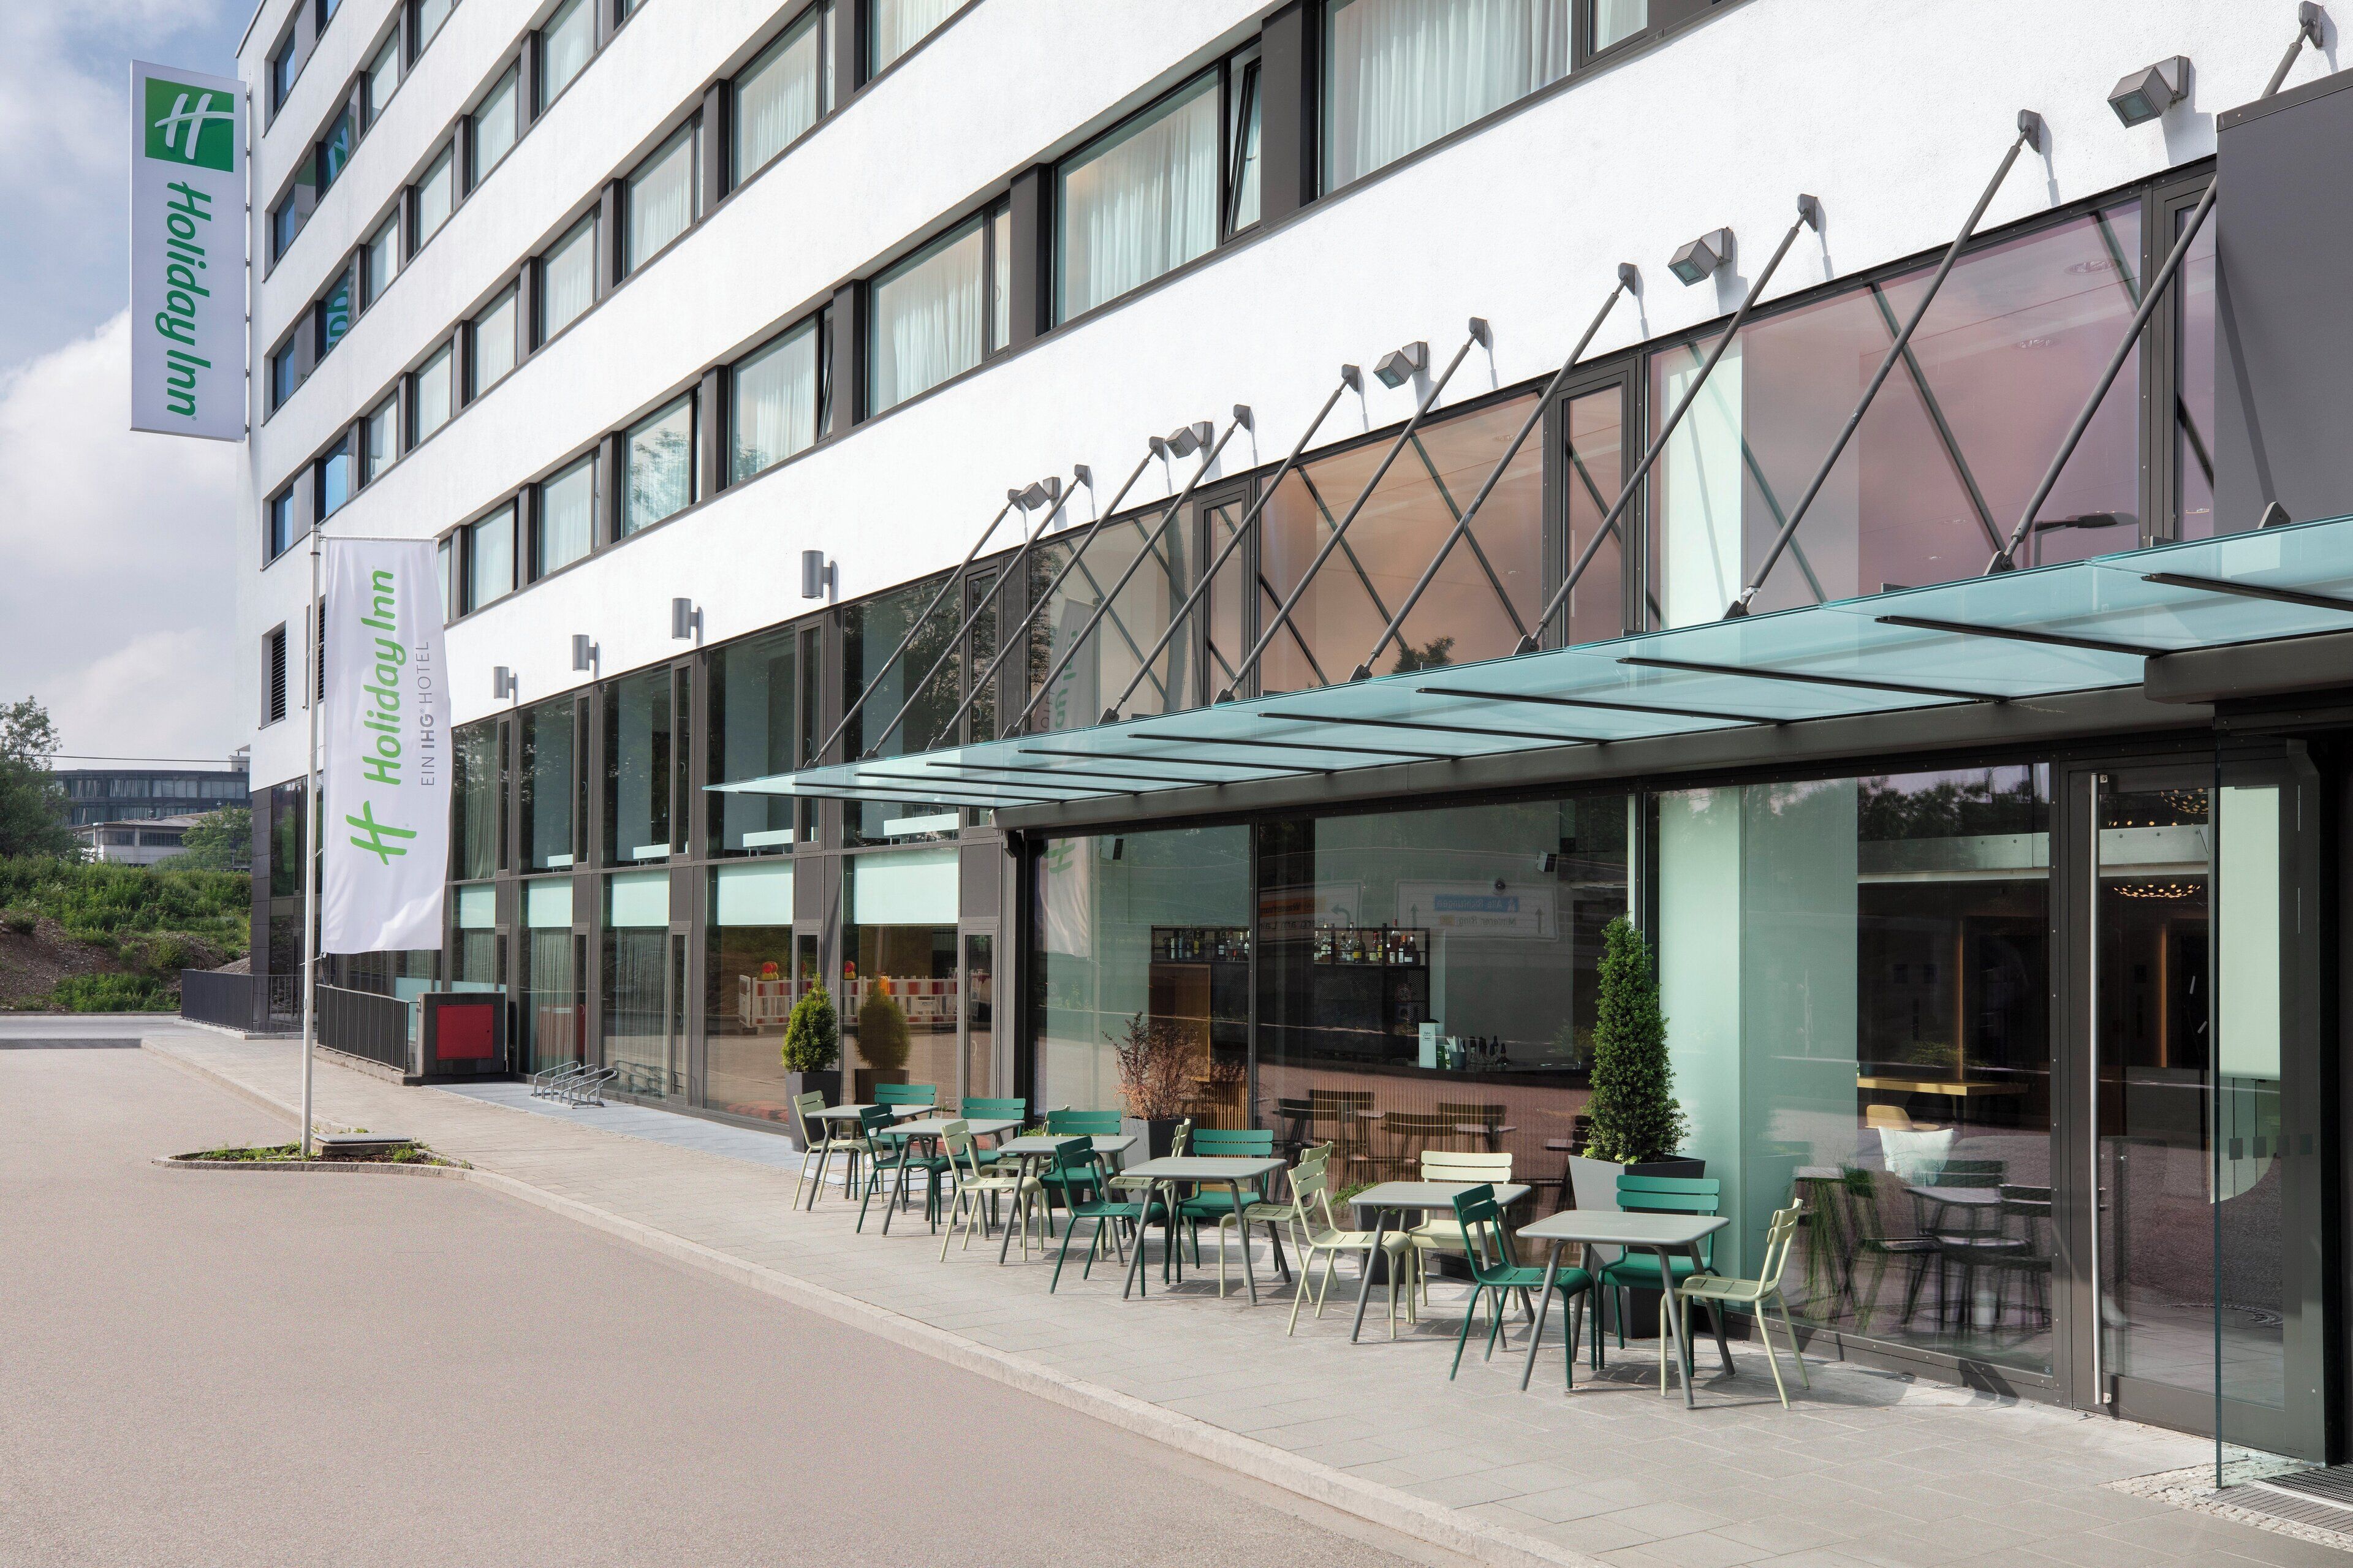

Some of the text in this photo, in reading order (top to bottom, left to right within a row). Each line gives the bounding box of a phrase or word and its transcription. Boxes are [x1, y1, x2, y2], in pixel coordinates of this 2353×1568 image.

[155, 181, 211, 417] Holiday Inn
[360, 569, 407, 786] Holiday Inn
[415, 642, 433, 704] HOTEL
[420, 757, 435, 786] EIN
